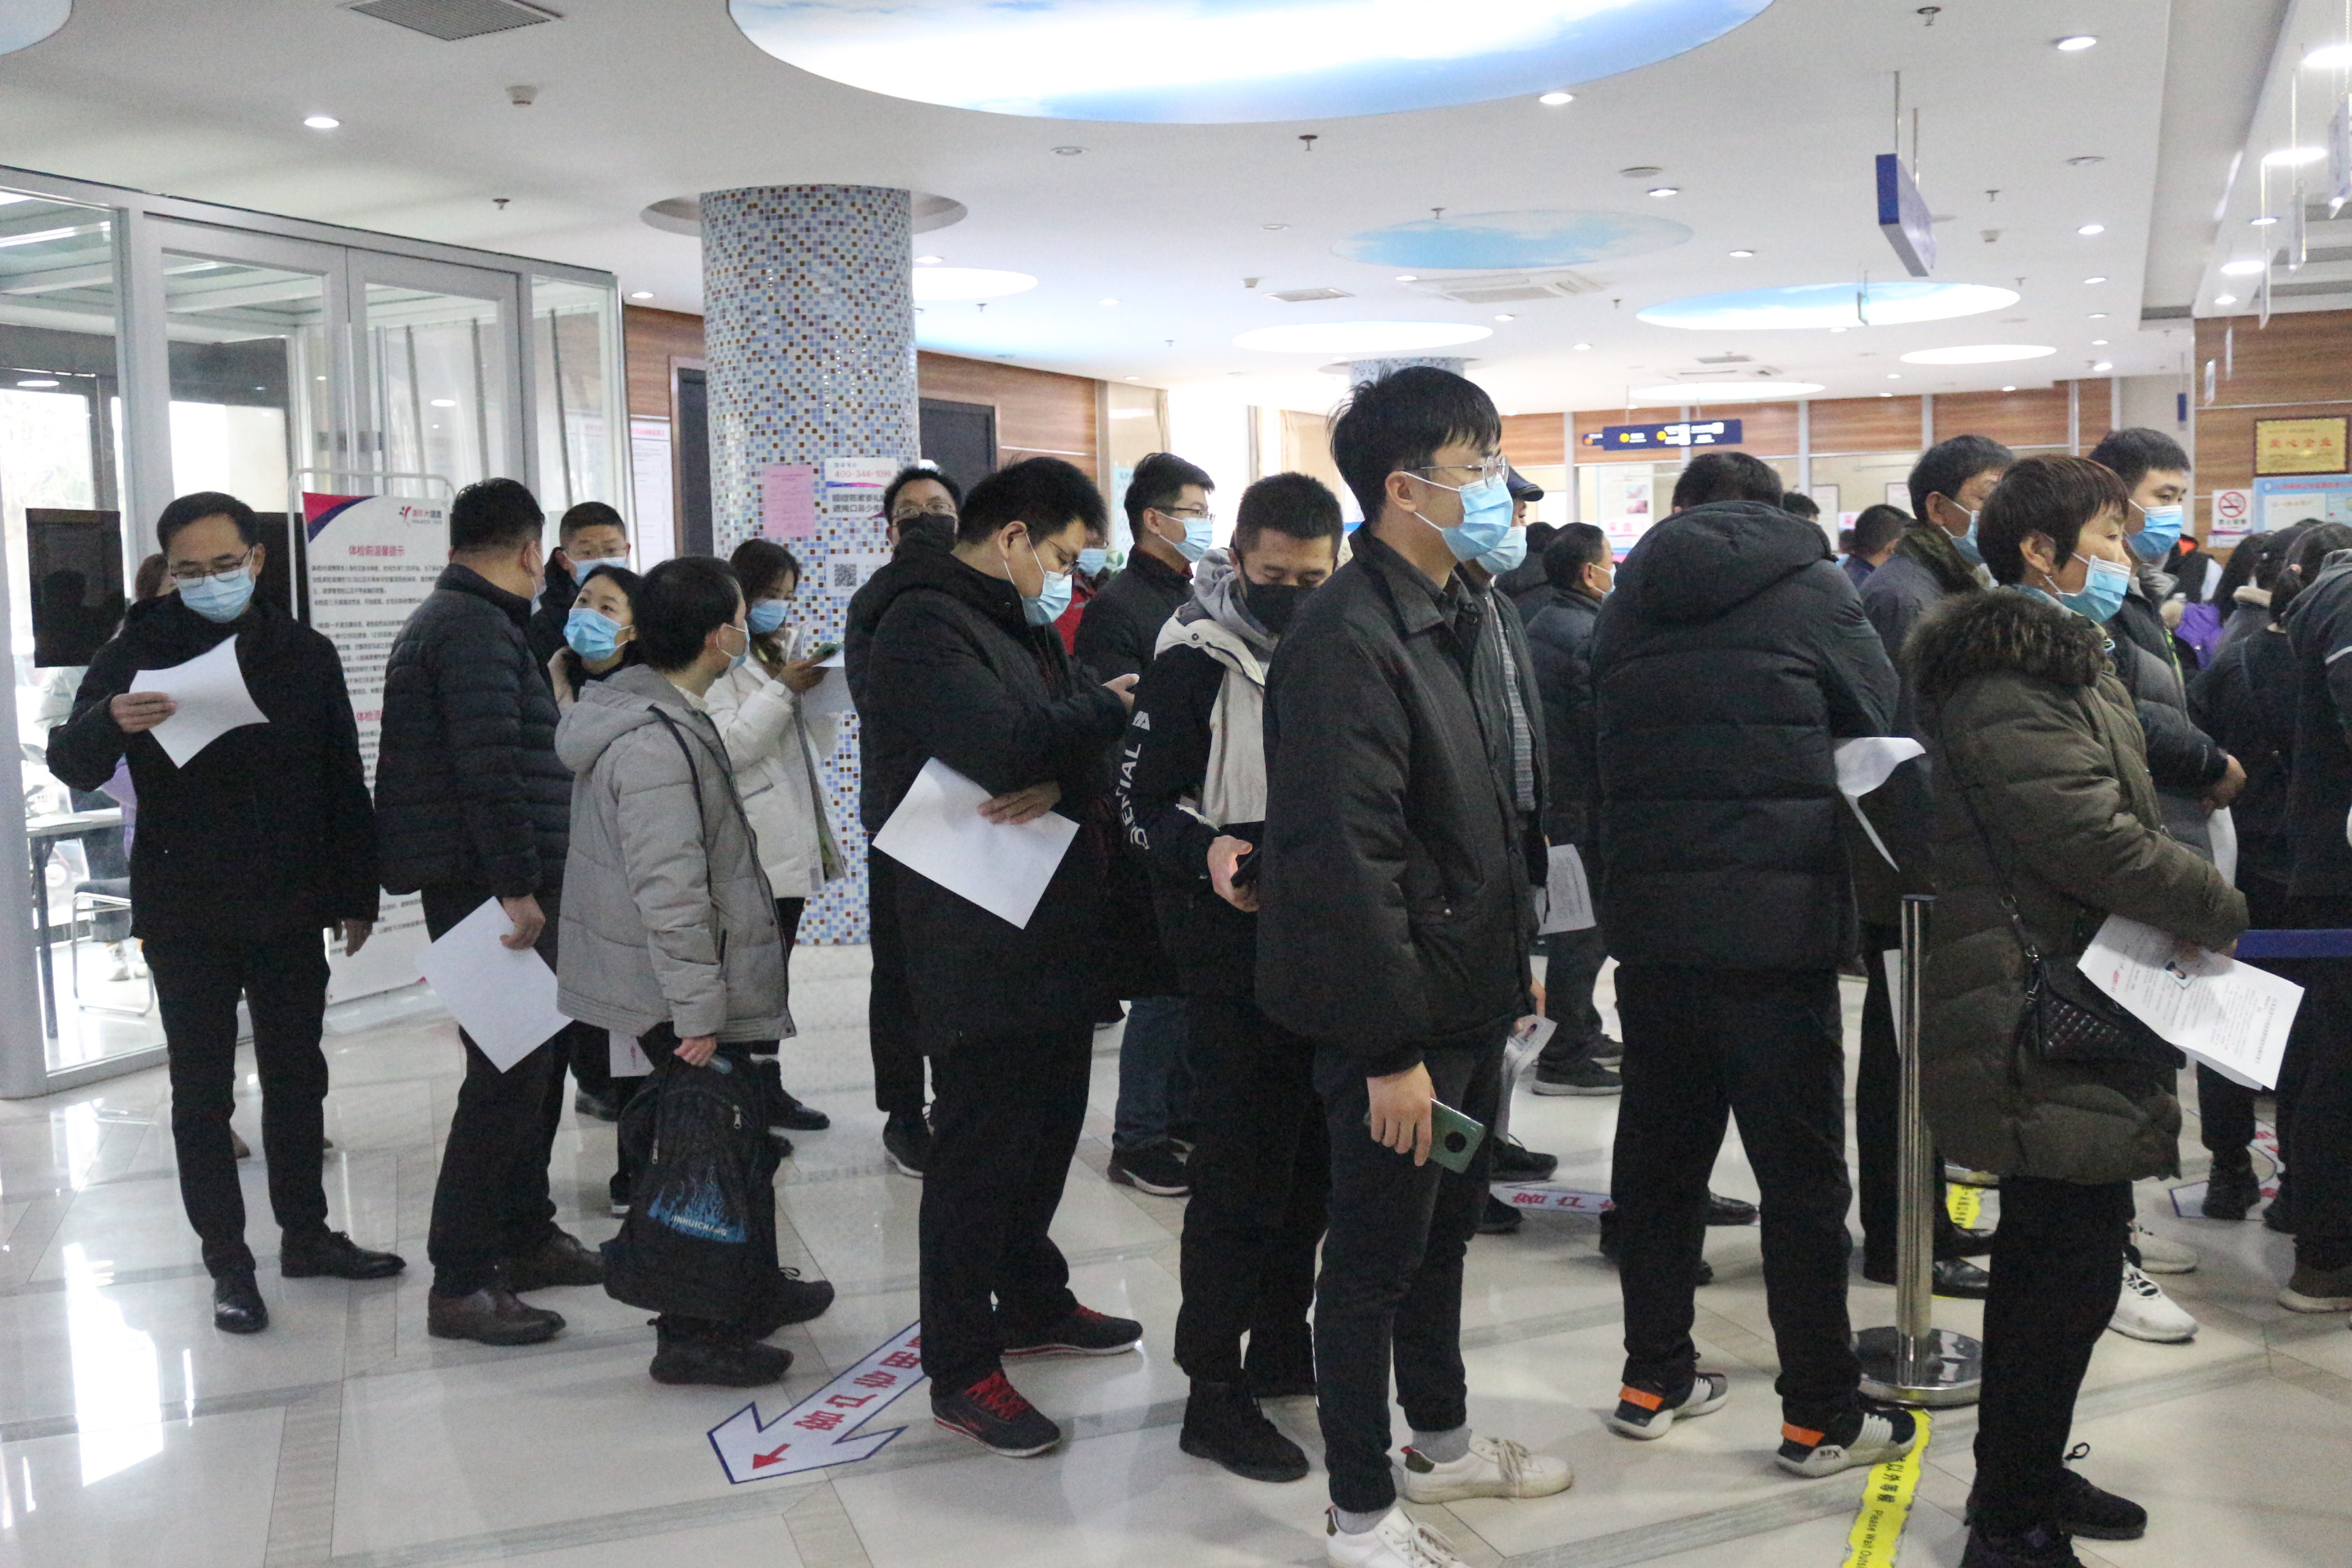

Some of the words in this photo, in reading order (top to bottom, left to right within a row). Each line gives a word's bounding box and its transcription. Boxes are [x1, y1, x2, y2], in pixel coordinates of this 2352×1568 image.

[348, 544, 406, 557] 体检前温馨提示
[1876, 1458, 1906, 1503] 以外等候
[1867, 1510, 1884, 1532] Please
